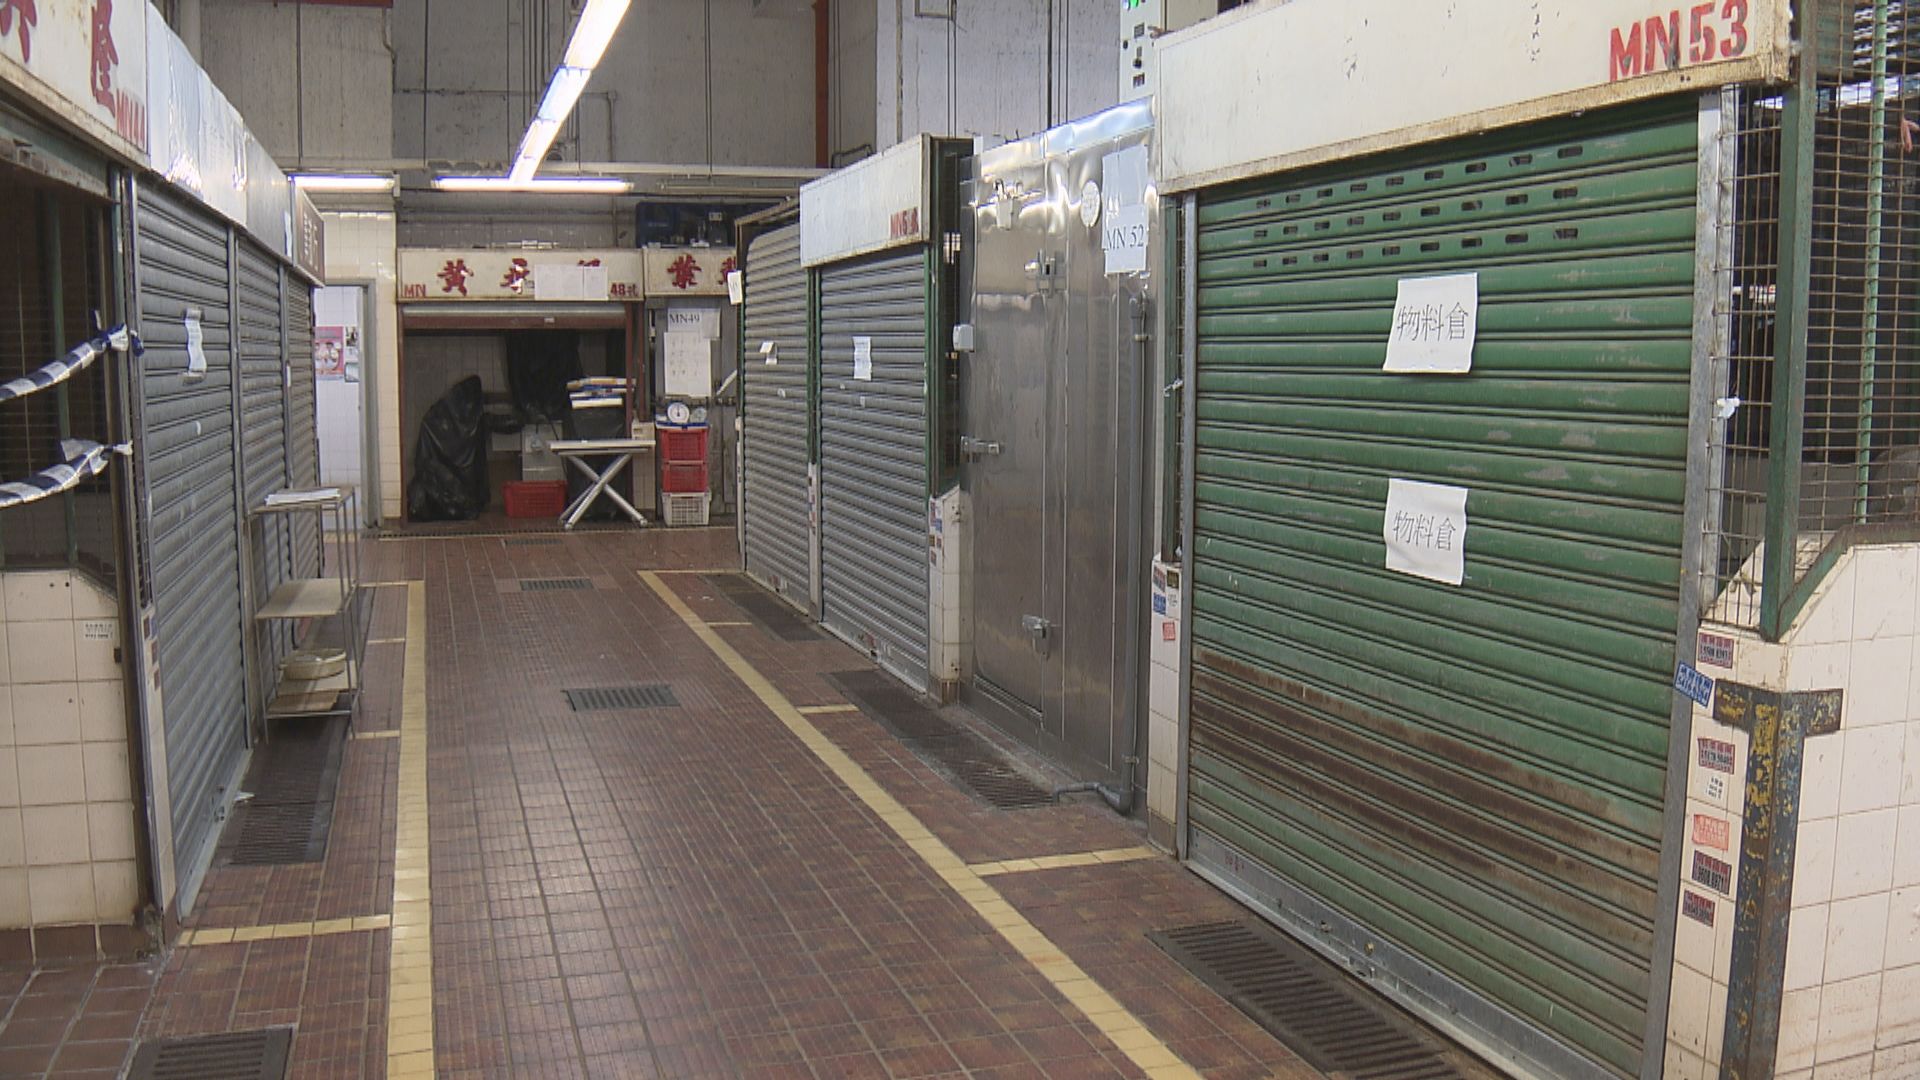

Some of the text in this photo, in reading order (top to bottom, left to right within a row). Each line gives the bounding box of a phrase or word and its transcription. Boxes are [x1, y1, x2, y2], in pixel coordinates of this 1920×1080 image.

[1610, 0, 1748, 81] MN 53
[1107, 224, 1144, 251] MN 52
[404, 284, 426, 298] MN
[669, 313, 700, 324] MN49
[1397, 302, 1468, 341] 物料倉
[1393, 510, 1456, 551] 物料倉
